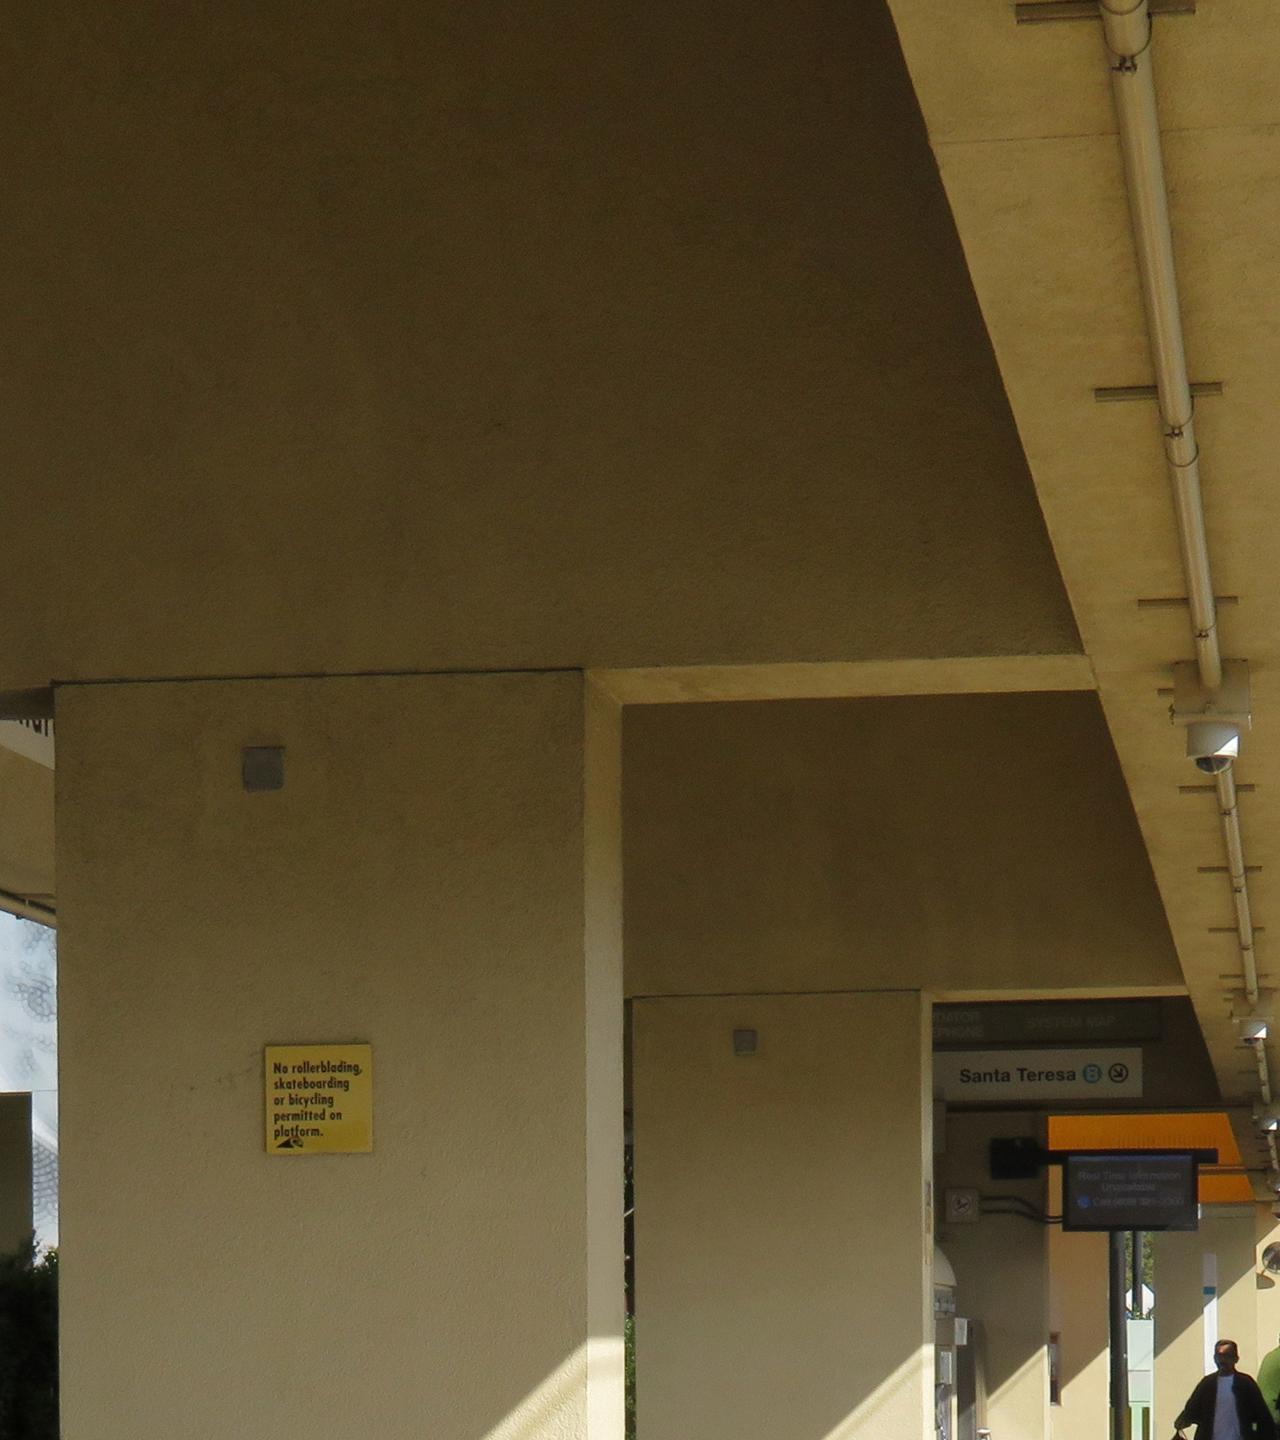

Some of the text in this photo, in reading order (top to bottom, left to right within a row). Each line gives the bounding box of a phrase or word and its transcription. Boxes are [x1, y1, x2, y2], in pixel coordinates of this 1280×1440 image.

[273, 1060, 363, 1076] No rollerblading,
[959, 1068, 1011, 1084] Santa
[1016, 1067, 1077, 1083] Teresa
[273, 1077, 350, 1092] skateboarding
[273, 1092, 334, 1108] or bicycling
[273, 1108, 343, 1125] permitted on
[273, 1125, 324, 1140] platform.
